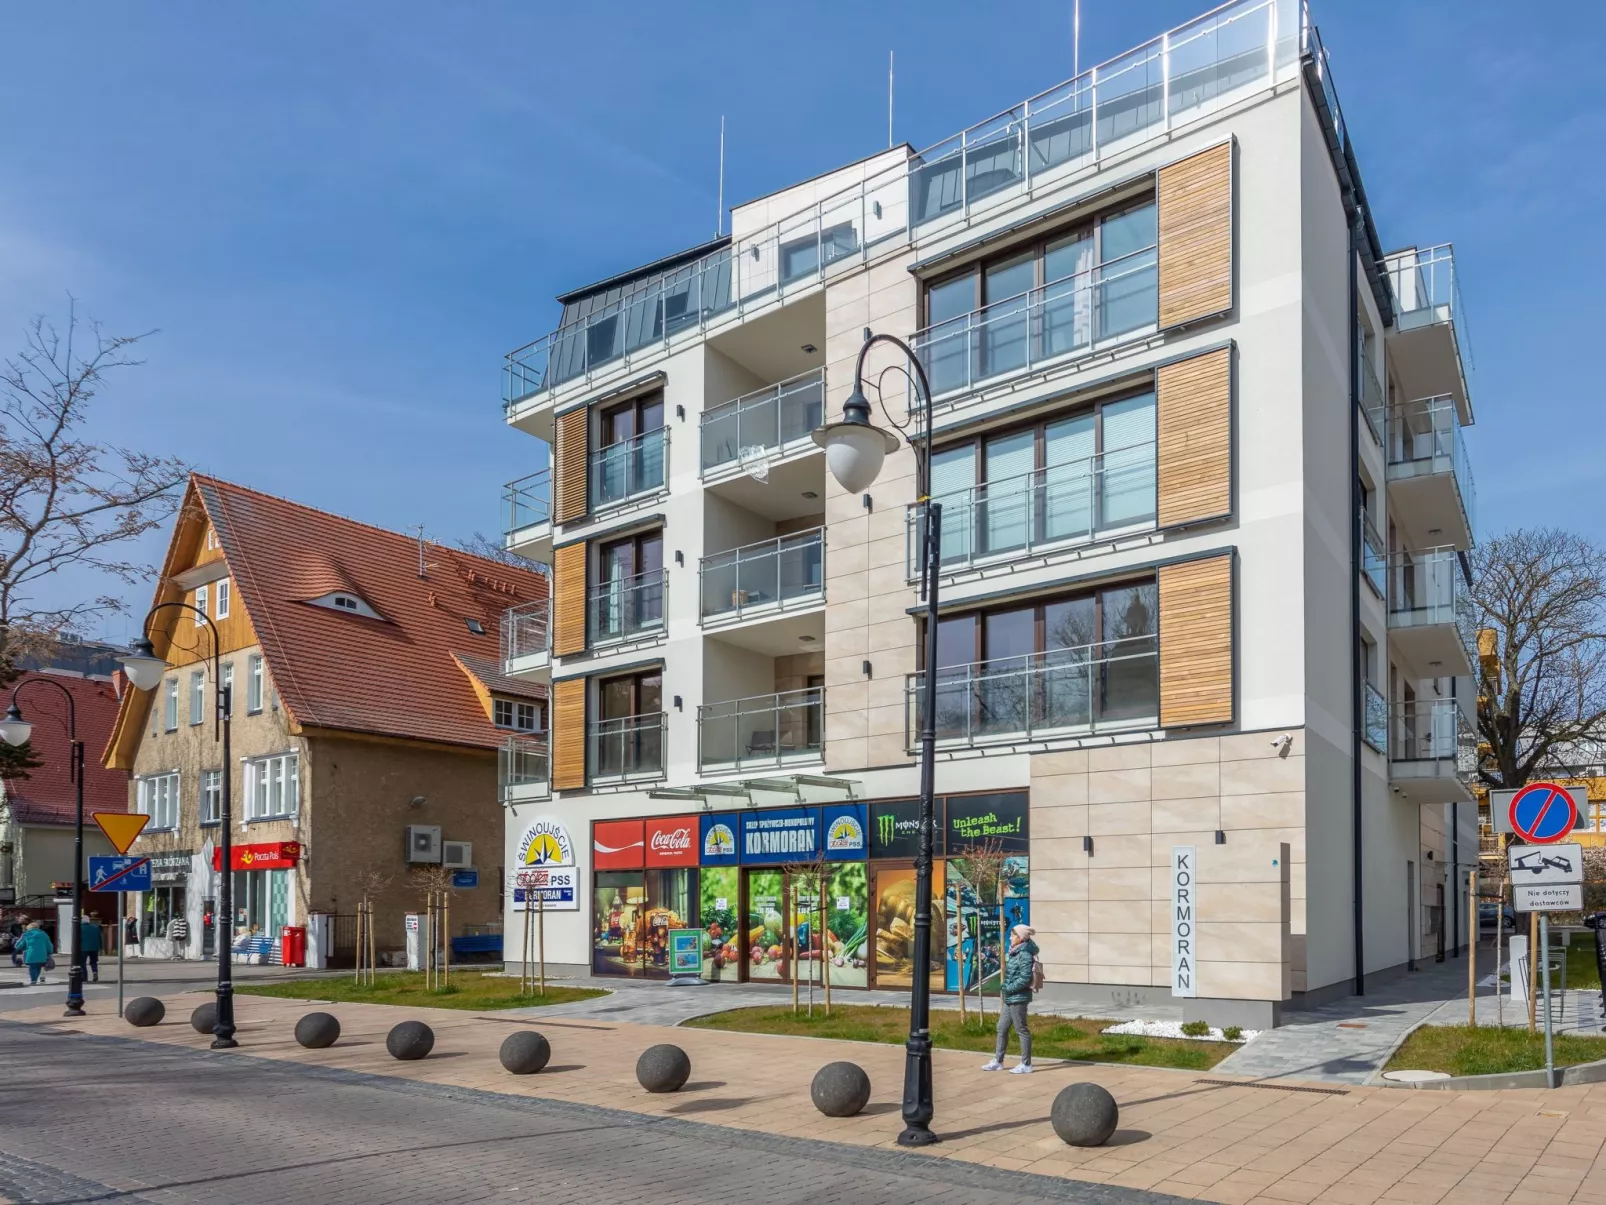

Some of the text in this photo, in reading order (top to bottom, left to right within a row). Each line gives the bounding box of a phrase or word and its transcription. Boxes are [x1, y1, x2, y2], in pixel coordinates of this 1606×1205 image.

[952, 812, 998, 829] Unleash
[961, 826, 981, 838] the
[518, 822, 569, 862] ŚWINOUJŚCIE
[745, 829, 815, 854] KORMORAN
[551, 875, 571, 886] PSS
[1542, 889, 1570, 897] dotyczy
[1177, 854, 1191, 989] KORMORAN
